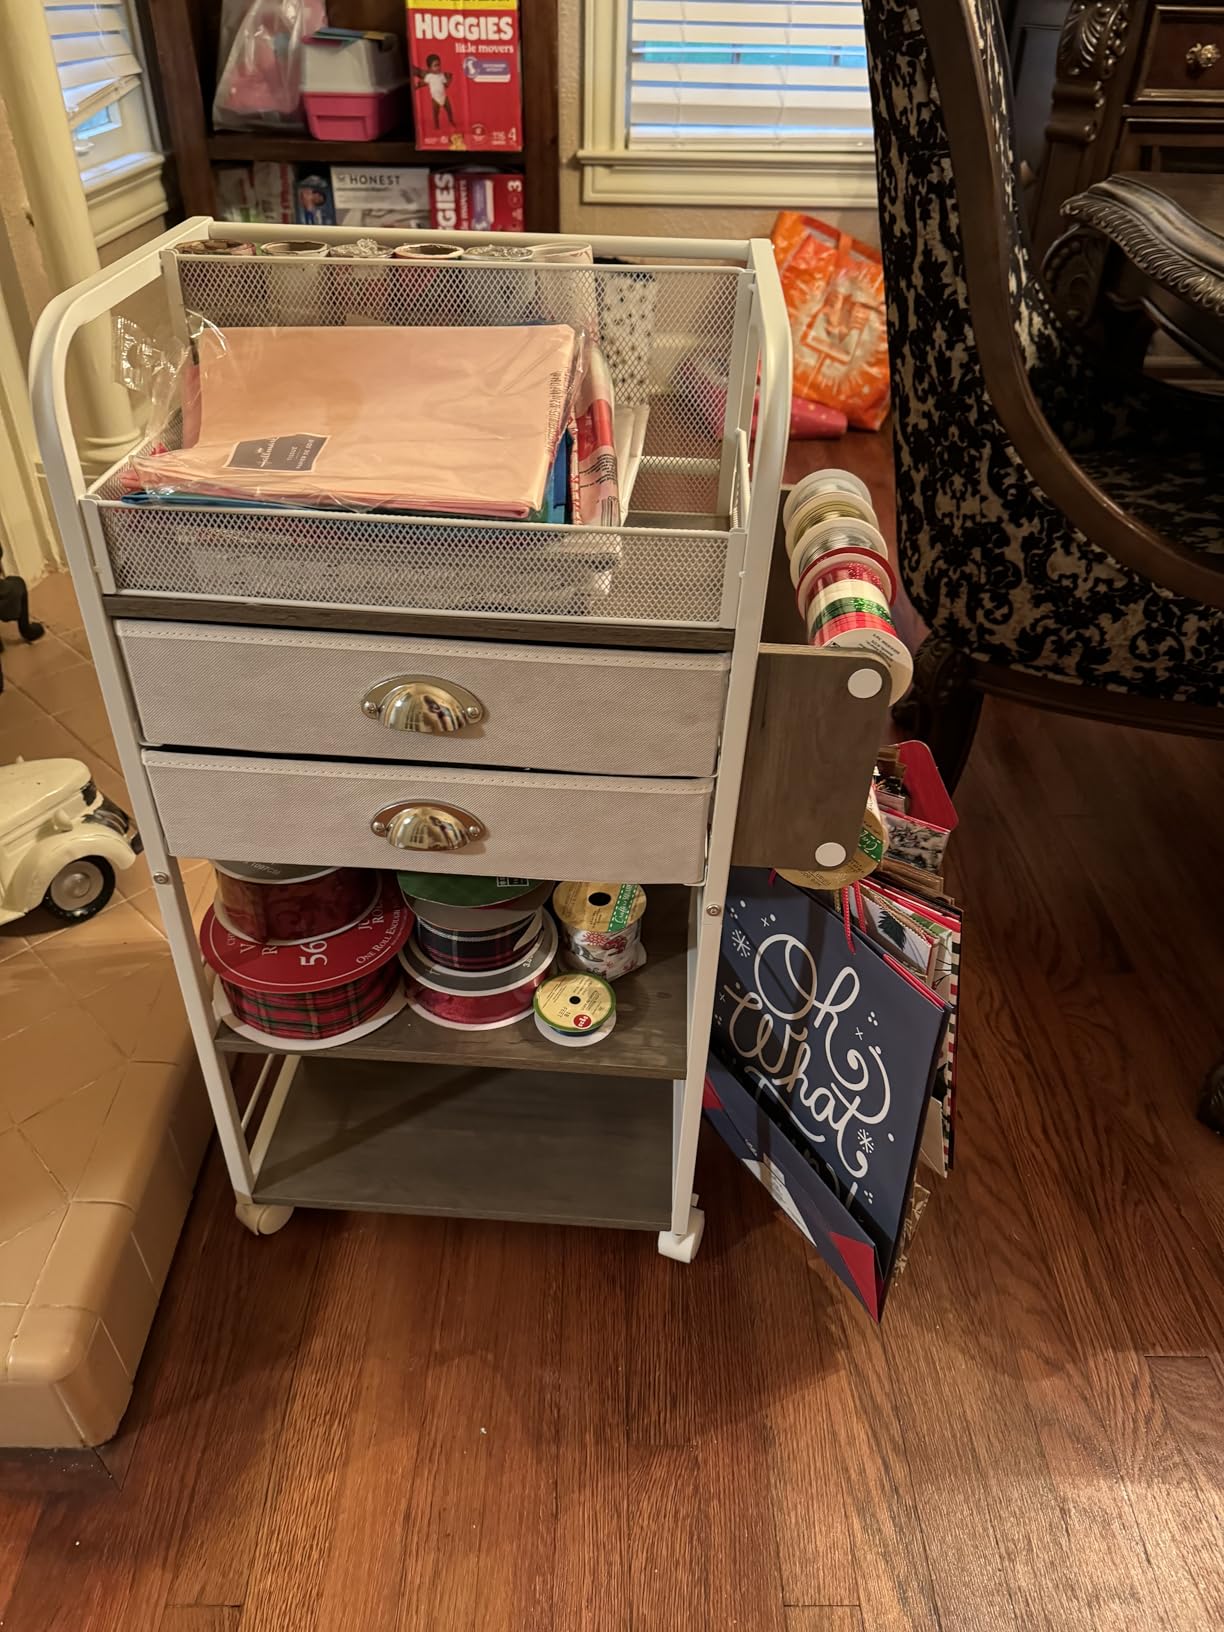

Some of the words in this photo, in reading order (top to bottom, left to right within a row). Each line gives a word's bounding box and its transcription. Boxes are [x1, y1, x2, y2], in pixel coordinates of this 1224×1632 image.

[414, 13, 513, 40] HUGGIES
[478, 45, 514, 54] movers
[508, 127, 516, 142] 4
[349, 173, 400, 186] HONEST
[507, 180, 522, 192] 3
[434, 173, 457, 230] GIES
[753, 933, 870, 1092] Oh
[723, 982, 891, 1179] What
